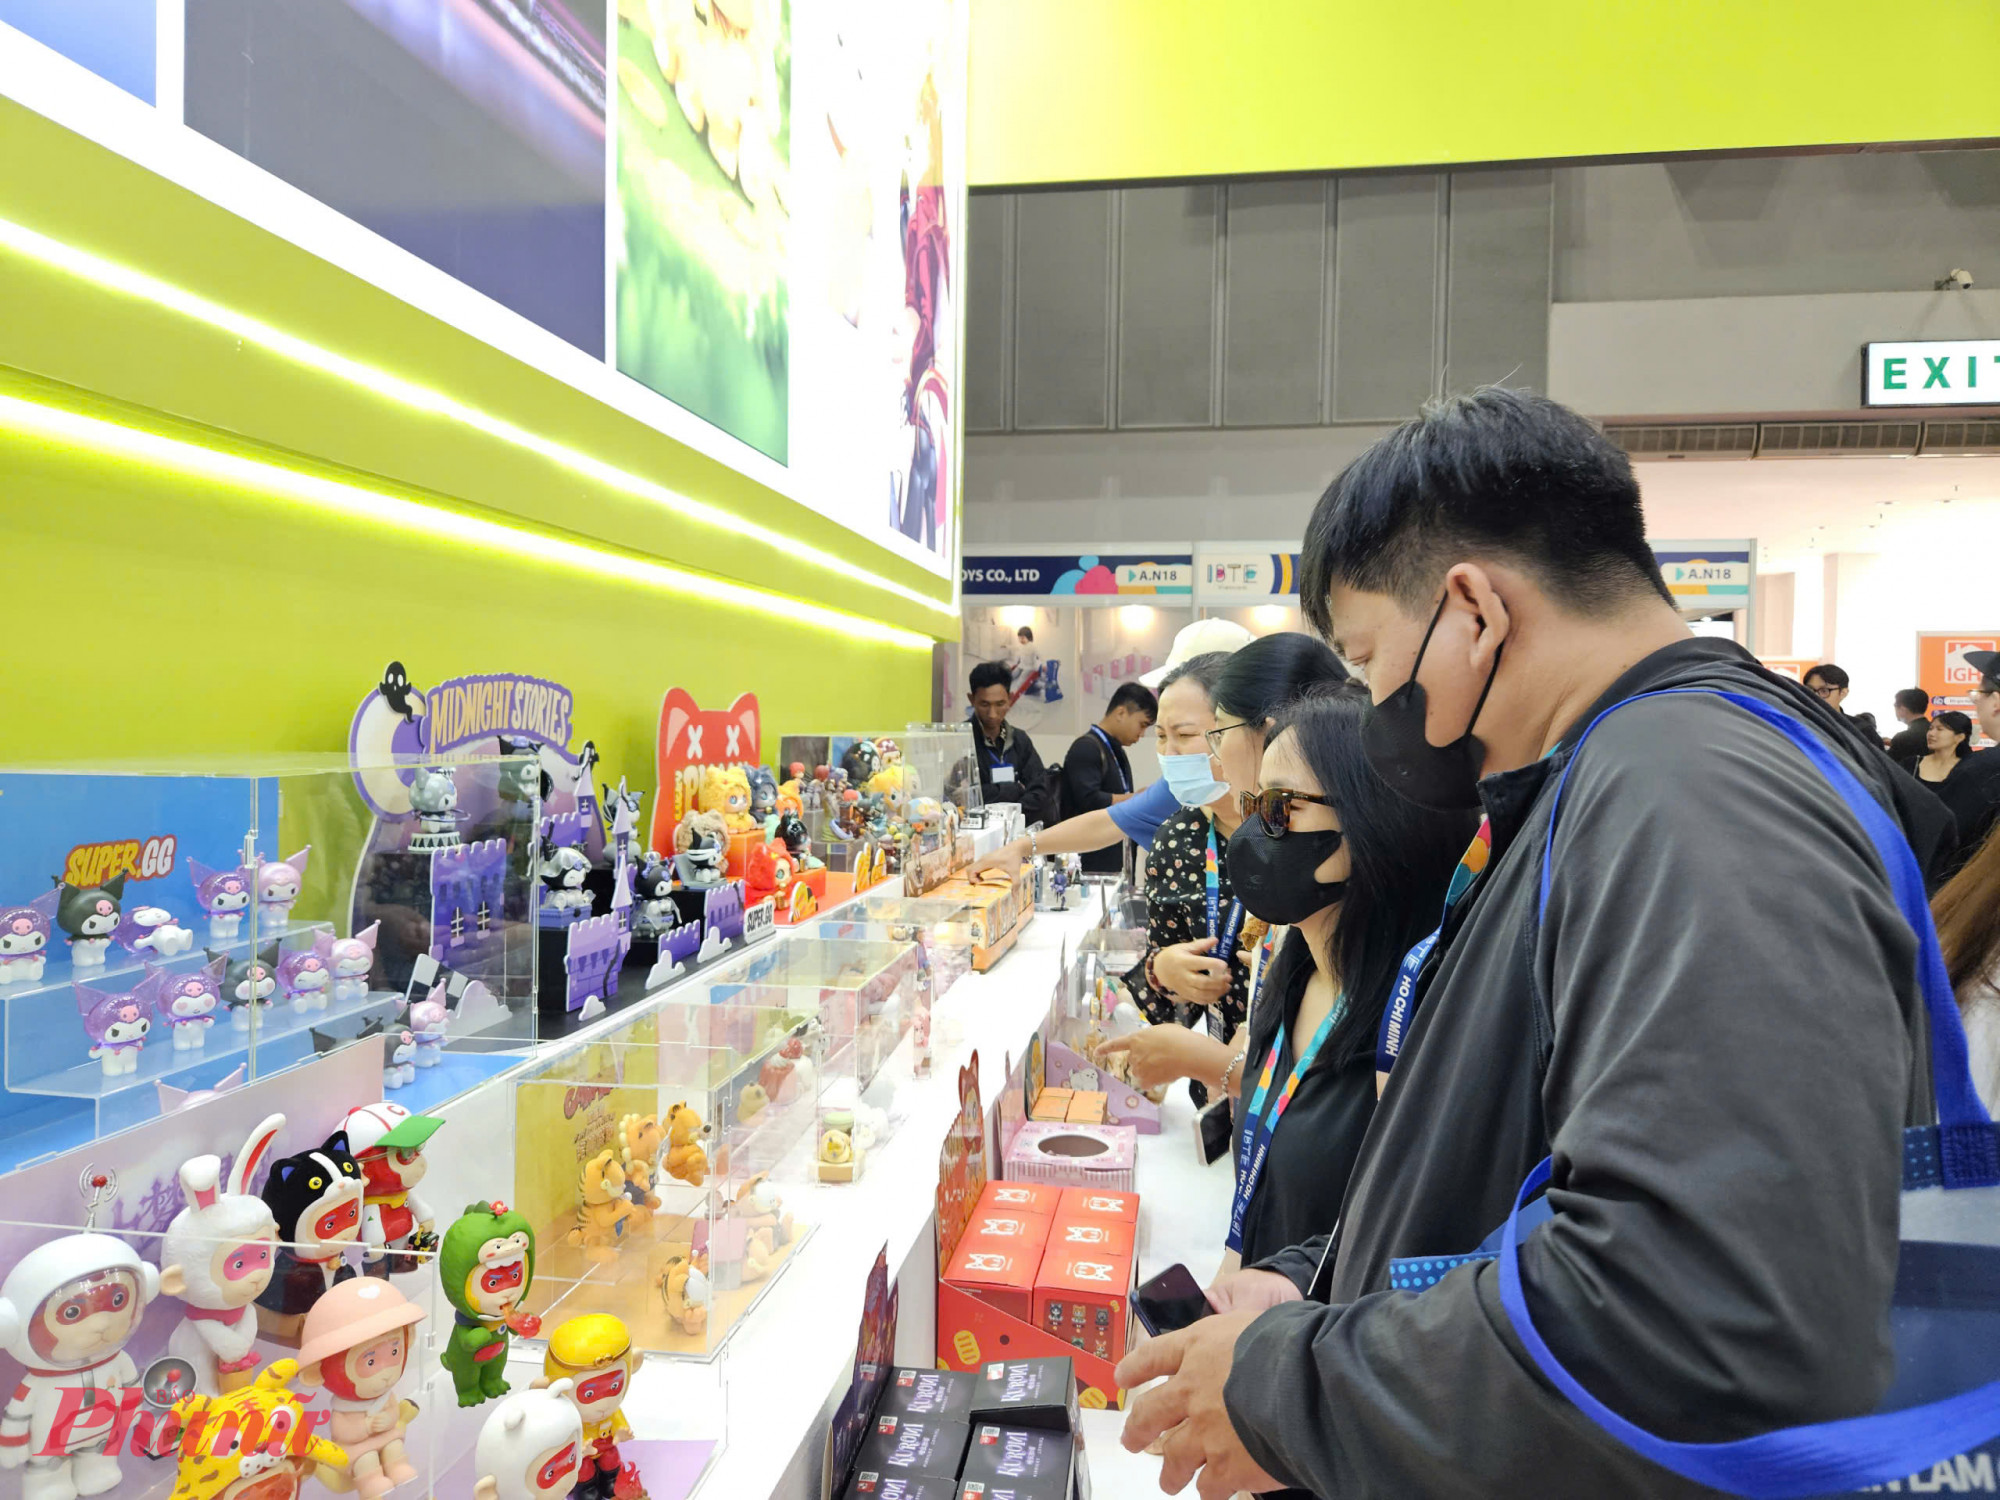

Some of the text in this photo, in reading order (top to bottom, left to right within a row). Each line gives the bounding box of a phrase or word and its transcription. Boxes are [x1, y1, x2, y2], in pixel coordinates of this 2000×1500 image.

[1883, 355, 2000, 390] EXI
[986, 569, 1012, 583] CO.,
[1014, 569, 1040, 582] LTD
[1139, 570, 1177, 581] A.N18
[1688, 568, 1731, 580] A.N18
[430, 681, 570, 755] MIDNIGHT STORIES
